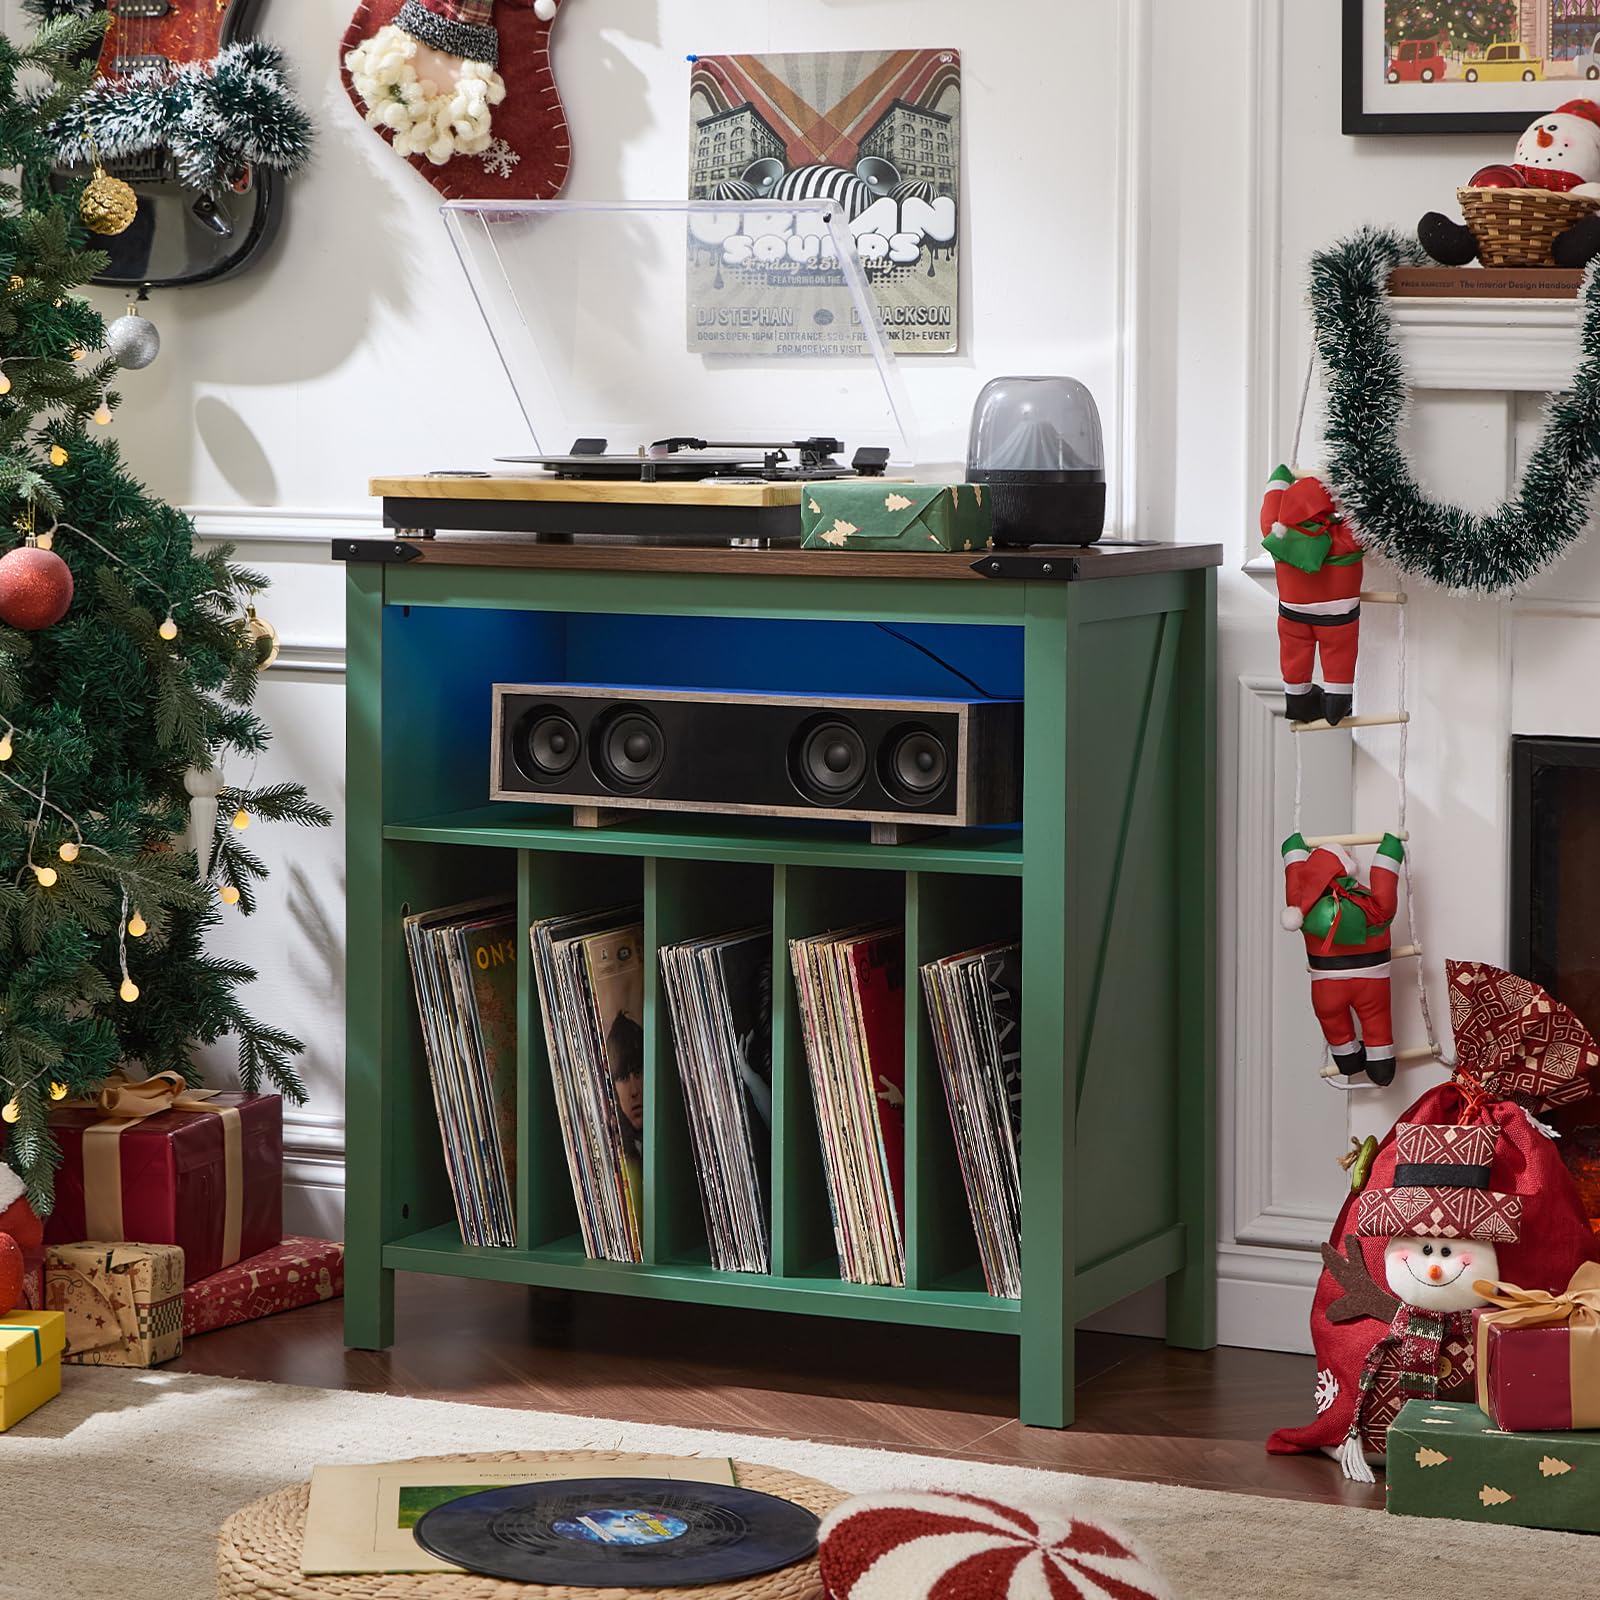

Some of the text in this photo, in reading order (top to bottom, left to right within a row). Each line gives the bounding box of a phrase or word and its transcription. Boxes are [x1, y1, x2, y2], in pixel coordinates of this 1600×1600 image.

[742, 256, 801, 274] Friday
[806, 256, 845, 271] 25t
[1460, 280, 1474, 288] The
[1477, 280, 1507, 288] Interior
[1509, 280, 1537, 290] Design
[1539, 281, 1581, 289] Handbook
[696, 307, 793, 326] DJ STEPHAN
[779, 331, 826, 341] ENTRANCE:
[923, 331, 951, 340] EVENT
[777, 345, 792, 353] FOR
[794, 345, 818, 353] MORE
[840, 344, 862, 353] VISIT
